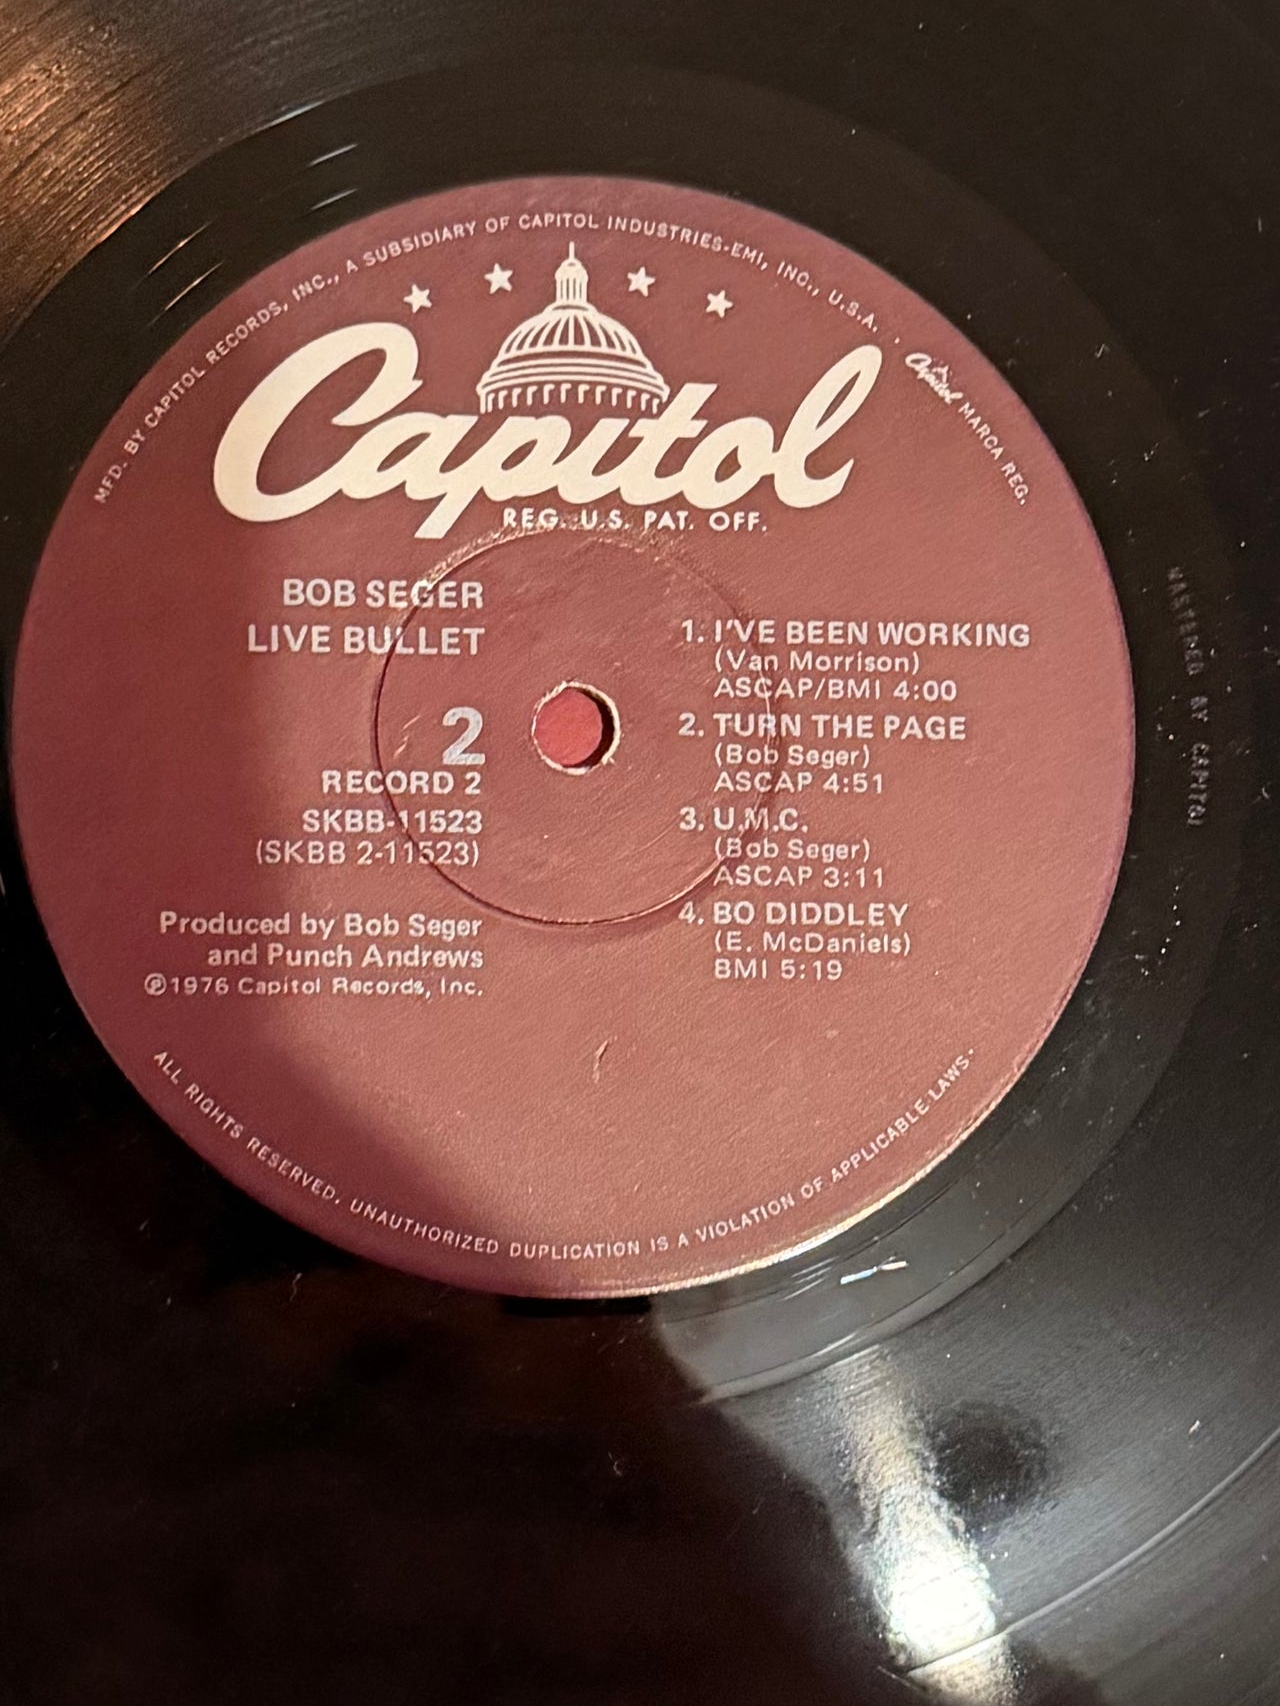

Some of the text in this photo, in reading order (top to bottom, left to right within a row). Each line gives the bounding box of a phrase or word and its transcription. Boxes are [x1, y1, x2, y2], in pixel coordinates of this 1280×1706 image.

[94, 462, 128, 504] MFD.
[123, 429, 146, 455] BY
[144, 366, 206, 429] CAPITOL
[205, 300, 289, 365] RECORDS,
[292, 274, 340, 302] INC.,
[346, 259, 359, 274] A
[362, 220, 476, 267] SUBSIDIARY
[485, 216, 511, 233] OF
[518, 213, 600, 230] CAPITOL
[607, 215, 769, 271] INDUSTRIES-EMI,
[776, 261, 820, 297] INC.,
[827, 289, 878, 333] U.S.A.
[957, 402, 1005, 461] MARCA
[1001, 460, 1029, 506] REG.
[213, 321, 883, 539] Capitol
[503, 507, 768, 532] REG. U.S. PAT. OFF.
[282, 578, 484, 610] BOB SEGER
[248, 624, 485, 656] LIVE BULLET
[680, 620, 1031, 647] 1. I'VE BEEN WORKING
[714, 648, 921, 675] (Van Morrison)
[713, 677, 958, 703] ASCAP/BMI 4:00
[441, 706, 486, 766] 2
[678, 713, 966, 741] 2. TURN THE PAGE
[714, 743, 870, 769] (Bob Seger)
[321, 771, 482, 795] RECORD 2
[713, 770, 884, 795] ASCAP 4:51
[302, 809, 483, 835] SKBB-11523
[679, 807, 808, 833] 3. U.M.C.
[256, 839, 479, 867] (SKBB 2-11523)
[714, 836, 870, 863] (Bob Seger)
[713, 864, 884, 889] ASCAP 3:11
[160, 910, 483, 942] Produced by Bob Seger
[678, 901, 909, 927] 4. BO DIDDLEY
[207, 943, 484, 968] and Punch Andrews
[714, 930, 911, 956] (E. McDaniels)
[714, 959, 843, 981] BMI 5:19
[237, 976, 321, 995] Capitol
[331, 976, 431, 999] Records,
[439, 978, 484, 997] Inc.
[154, 1051, 182, 1085] ALL
[184, 1083, 244, 1139] RIGHTS
[349, 1198, 499, 1255] UNAUTHORIZED
[509, 1240, 641, 1261] DUPLICATION
[650, 1236, 669, 1253] IS
[677, 1232, 690, 1248] A
[695, 1192, 795, 1243] VIOLATION
[800, 1176, 825, 1200] OF
[830, 1098, 929, 1184] APPLICABLE
